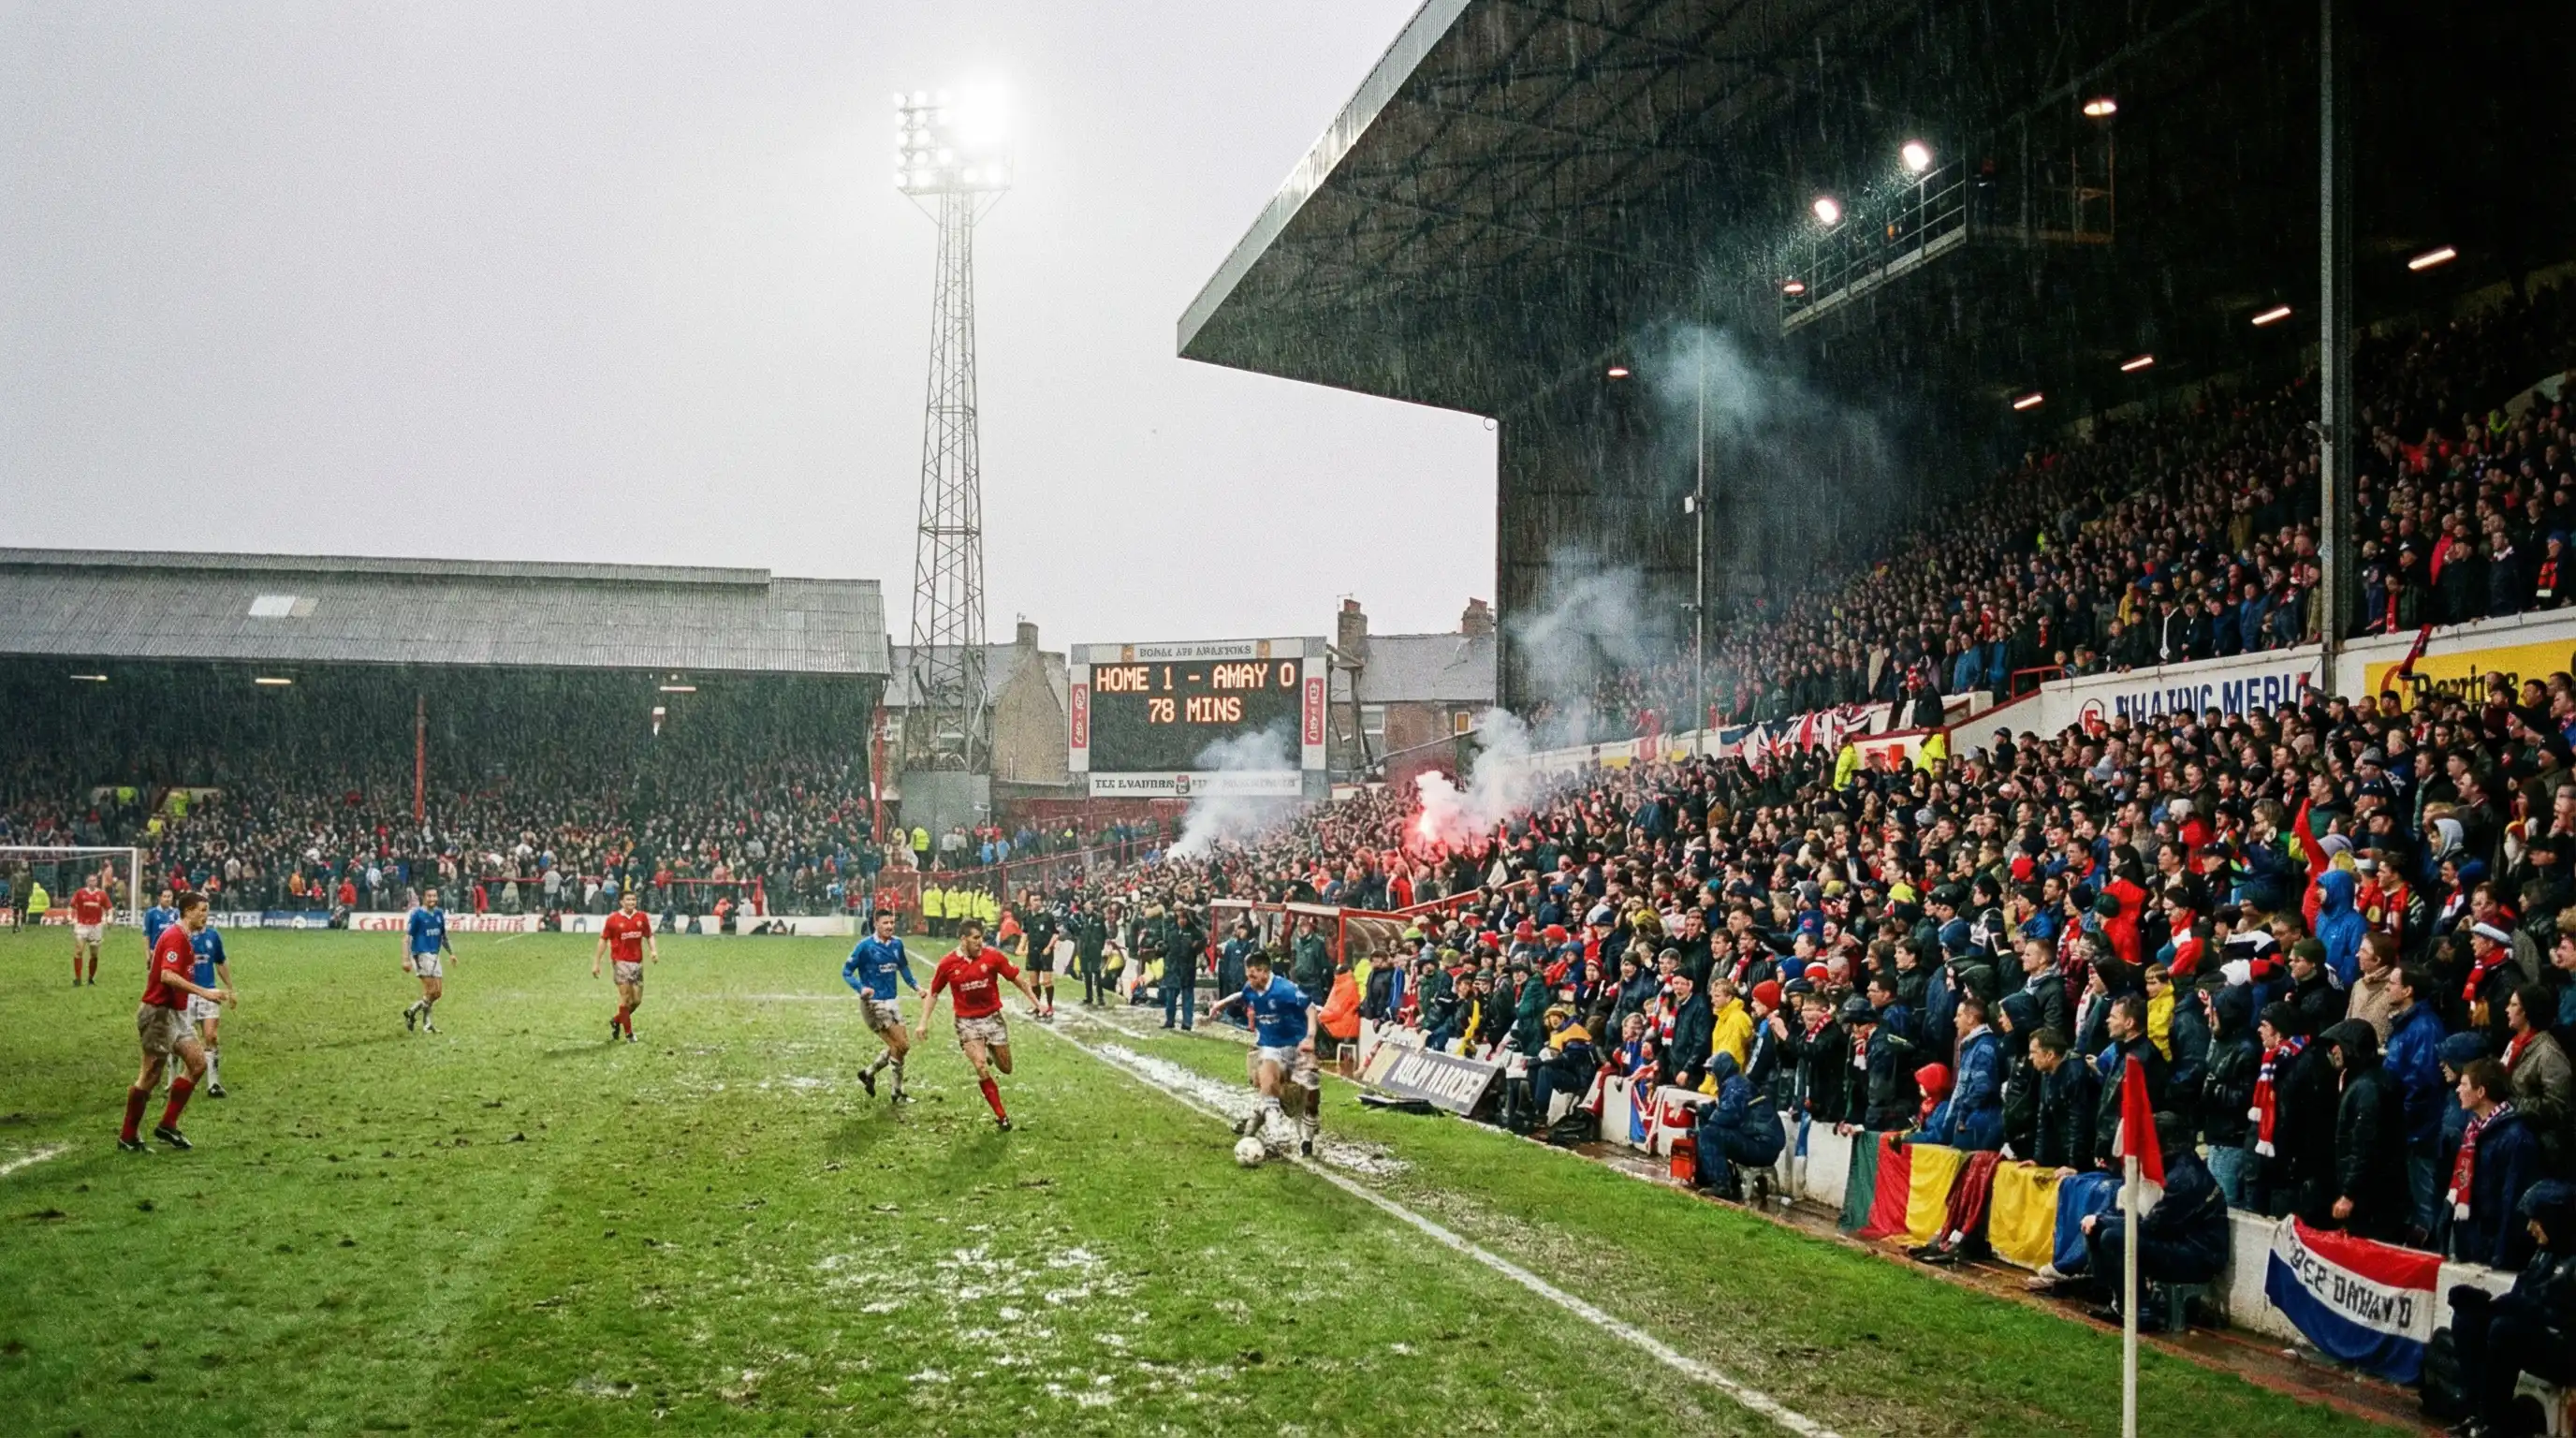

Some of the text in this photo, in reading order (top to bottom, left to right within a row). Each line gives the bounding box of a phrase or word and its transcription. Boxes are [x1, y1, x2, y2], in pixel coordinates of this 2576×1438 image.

[1096, 666, 1149, 691] HOME
[1164, 666, 1173, 690] 1
[1149, 697, 1241, 723] 78 MINS
